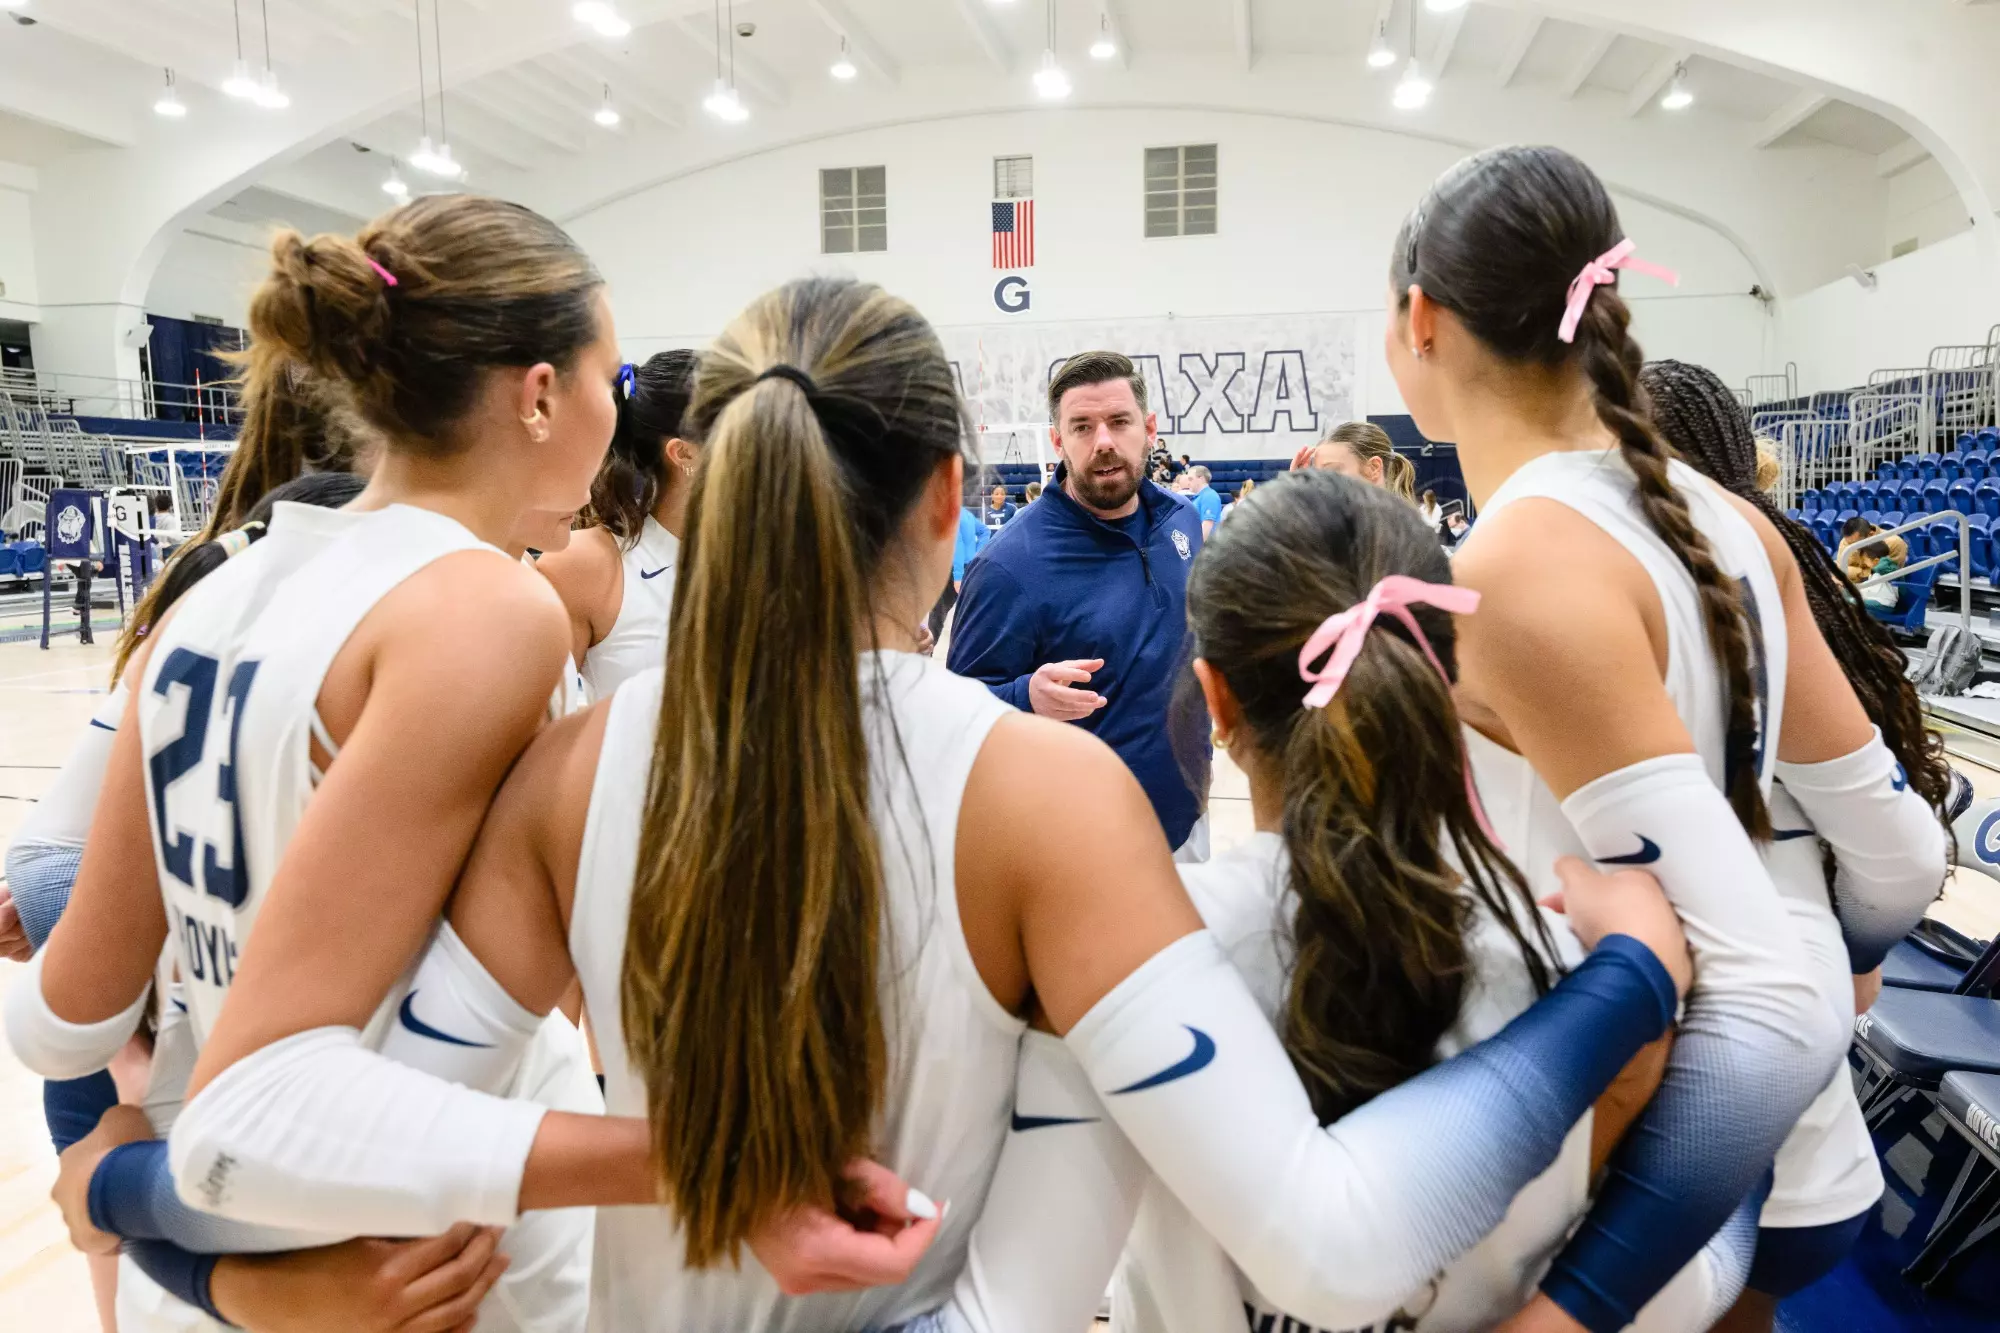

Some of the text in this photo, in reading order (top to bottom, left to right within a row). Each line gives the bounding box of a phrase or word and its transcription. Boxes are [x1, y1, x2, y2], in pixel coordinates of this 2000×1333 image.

[993, 275, 1031, 313] G
[1048, 349, 1318, 435] XA
[153, 646, 260, 908] 23
